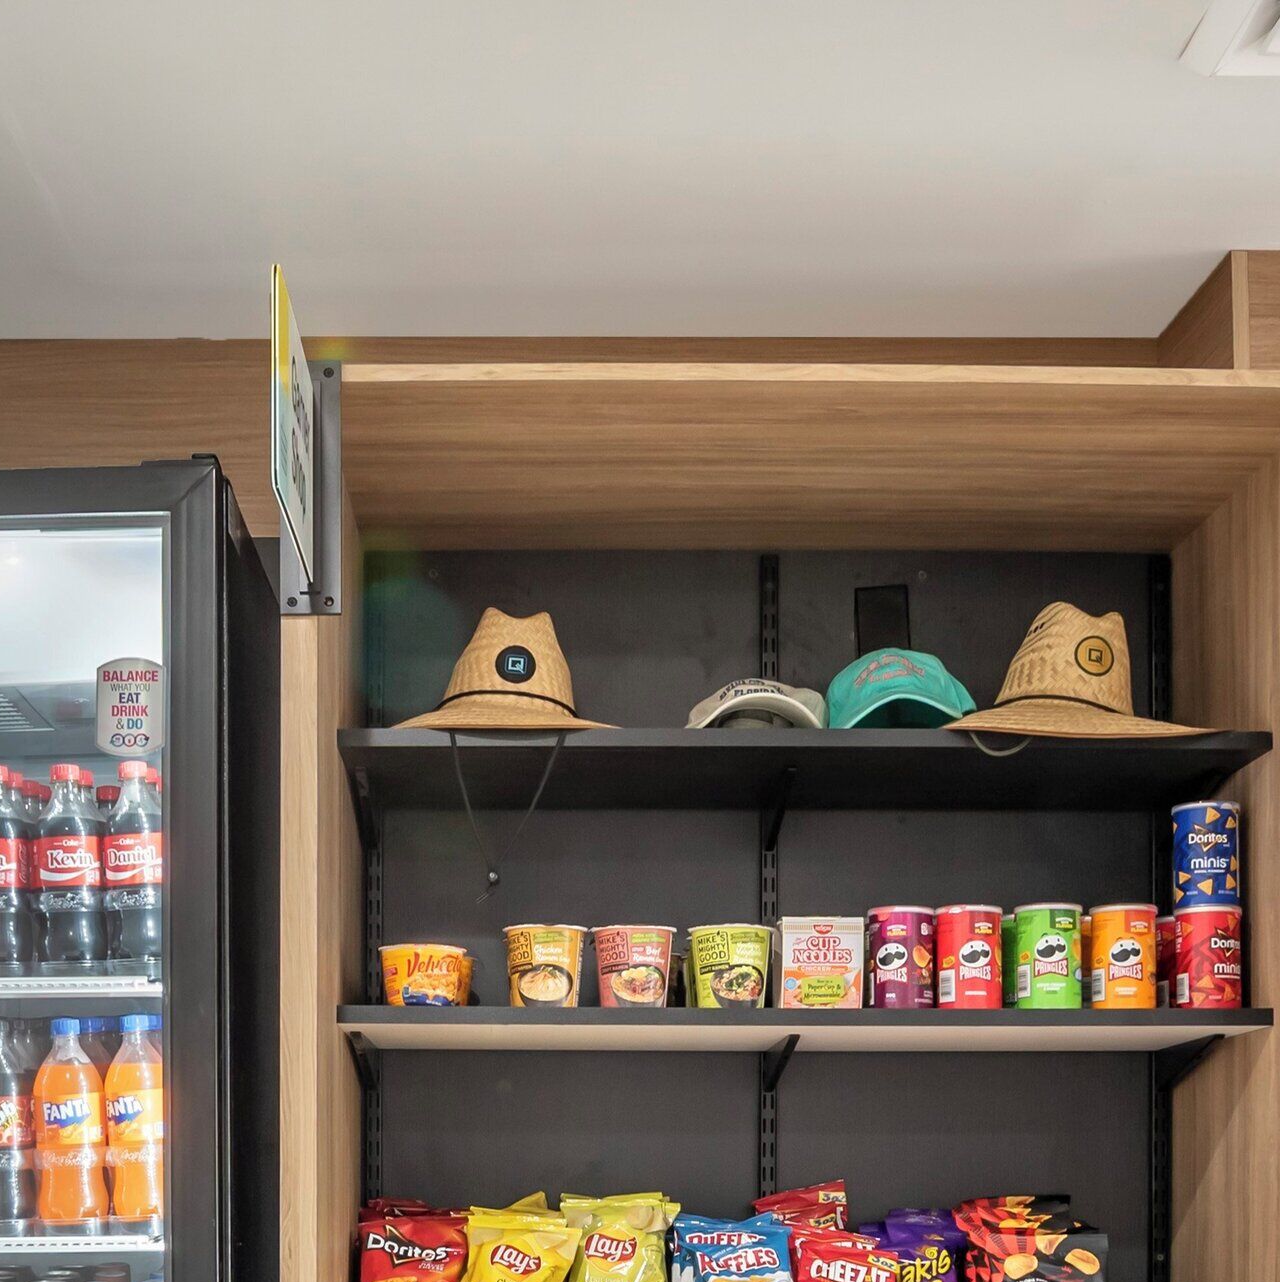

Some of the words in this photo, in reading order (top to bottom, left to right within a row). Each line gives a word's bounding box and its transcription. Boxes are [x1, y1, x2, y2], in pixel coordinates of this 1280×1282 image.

[103, 671, 158, 682] BALANCE
[110, 683, 132, 691] WHAT
[134, 683, 151, 691] YOU
[119, 692, 141, 704] EAT
[111, 705, 148, 717] DRINK
[116, 718, 124, 730] &
[127, 719, 143, 730] DO
[1188, 833, 1228, 845] Doritos
[47, 850, 94, 868] Kevin
[107, 846, 156, 866] Daniel
[1190, 857, 1228, 870] minis
[697, 934, 726, 945] MIKE'S
[806, 936, 841, 950] CUP
[600, 943, 626, 953] MIGHTY
[698, 943, 726, 953] MIGHTY
[600, 952, 626, 963] GOOD
[699, 951, 727, 963] GOOD
[791, 948, 853, 964] NOODLES
[407, 952, 463, 977] Velveeta
[1033, 961, 1069, 977] PRINGLES
[876, 968, 908, 983] PRINGLES
[959, 966, 992, 981] PRINGLES
[1108, 964, 1143, 980] PRINGLES
[42, 1097, 92, 1121] FANTA
[366, 1232, 451, 1262] Doritos
[585, 1233, 637, 1258] Lay's
[491, 1245, 543, 1275] Lay's
[697, 1248, 780, 1275] RUFFLES
